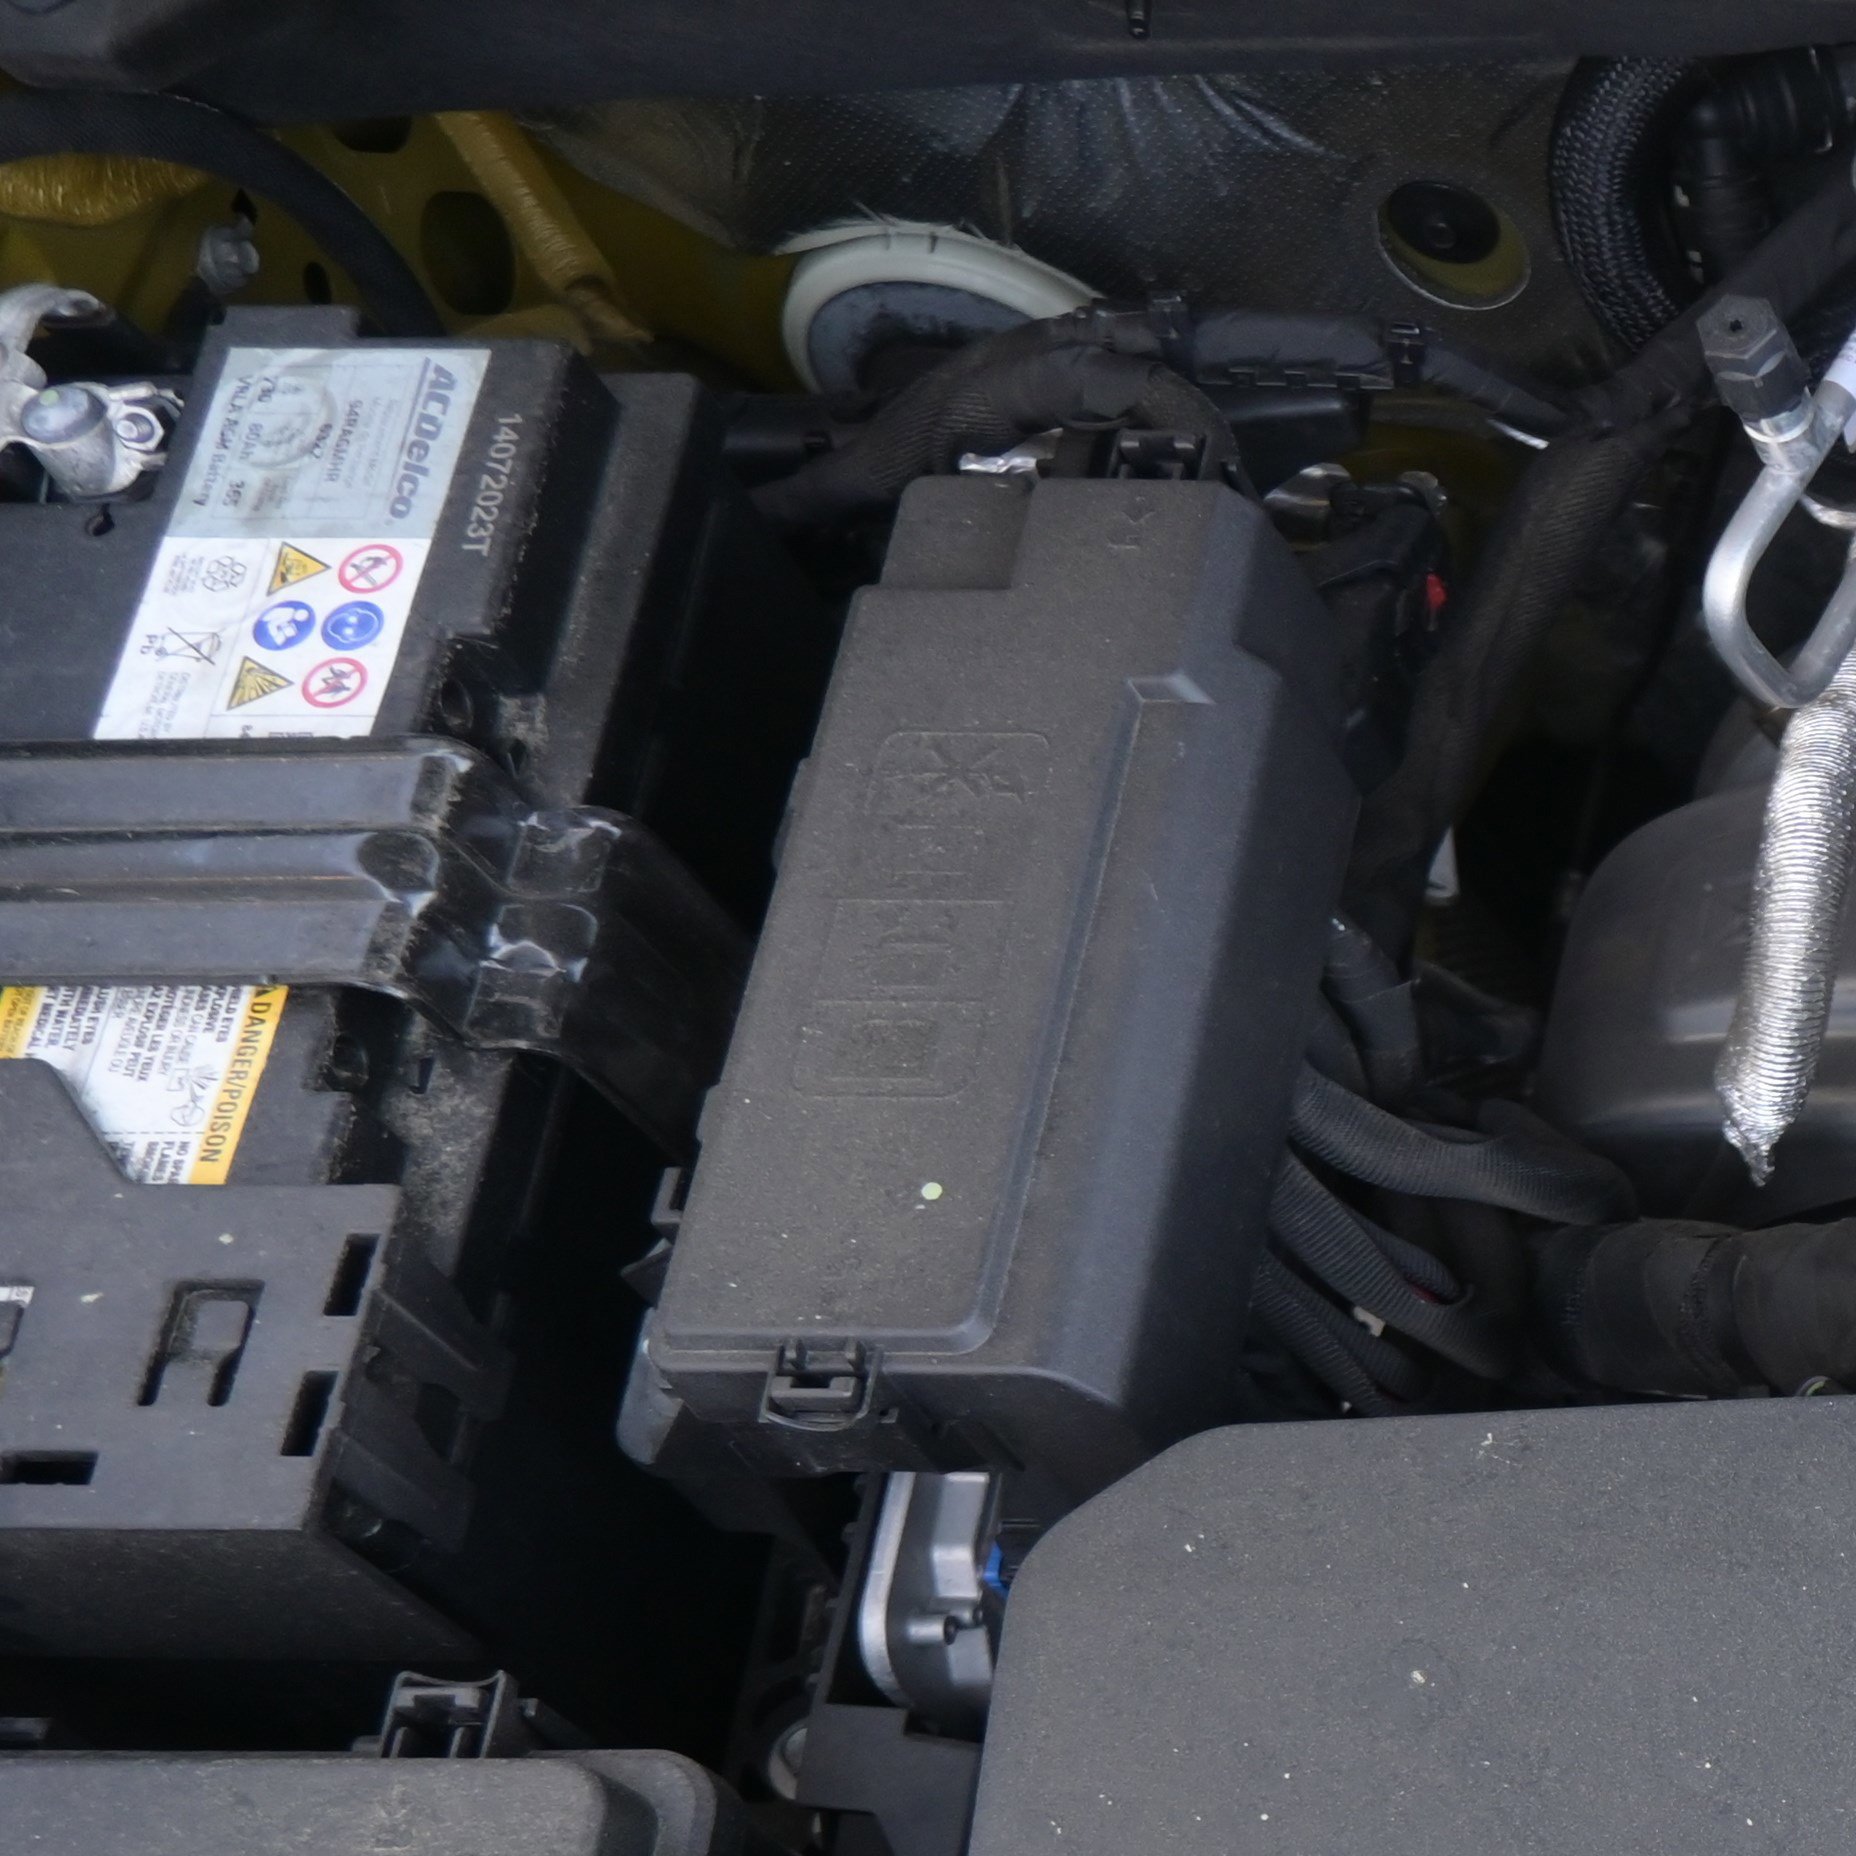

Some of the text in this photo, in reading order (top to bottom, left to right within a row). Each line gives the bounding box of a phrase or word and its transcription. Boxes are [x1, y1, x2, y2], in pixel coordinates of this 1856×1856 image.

[389, 364, 459, 520] ACDelco
[193, 453, 229, 507] Battery
[461, 414, 523, 557] 14072023T
[140, 635, 158, 655] Pb
[194, 987, 211, 1011] ASES
[26, 1004, 54, 1049] MEDICAL
[81, 1017, 99, 1045] EYES
[216, 1017, 234, 1043] EYES
[147, 1035, 164, 1052] LES
[122, 1052, 143, 1078] PEUT
[138, 1056, 156, 1081] YEUX
[199, 1002, 273, 1163] DANGER/POISON
[152, 1142, 175, 1181] FLAMES
[176, 1142, 191, 1155] NO
